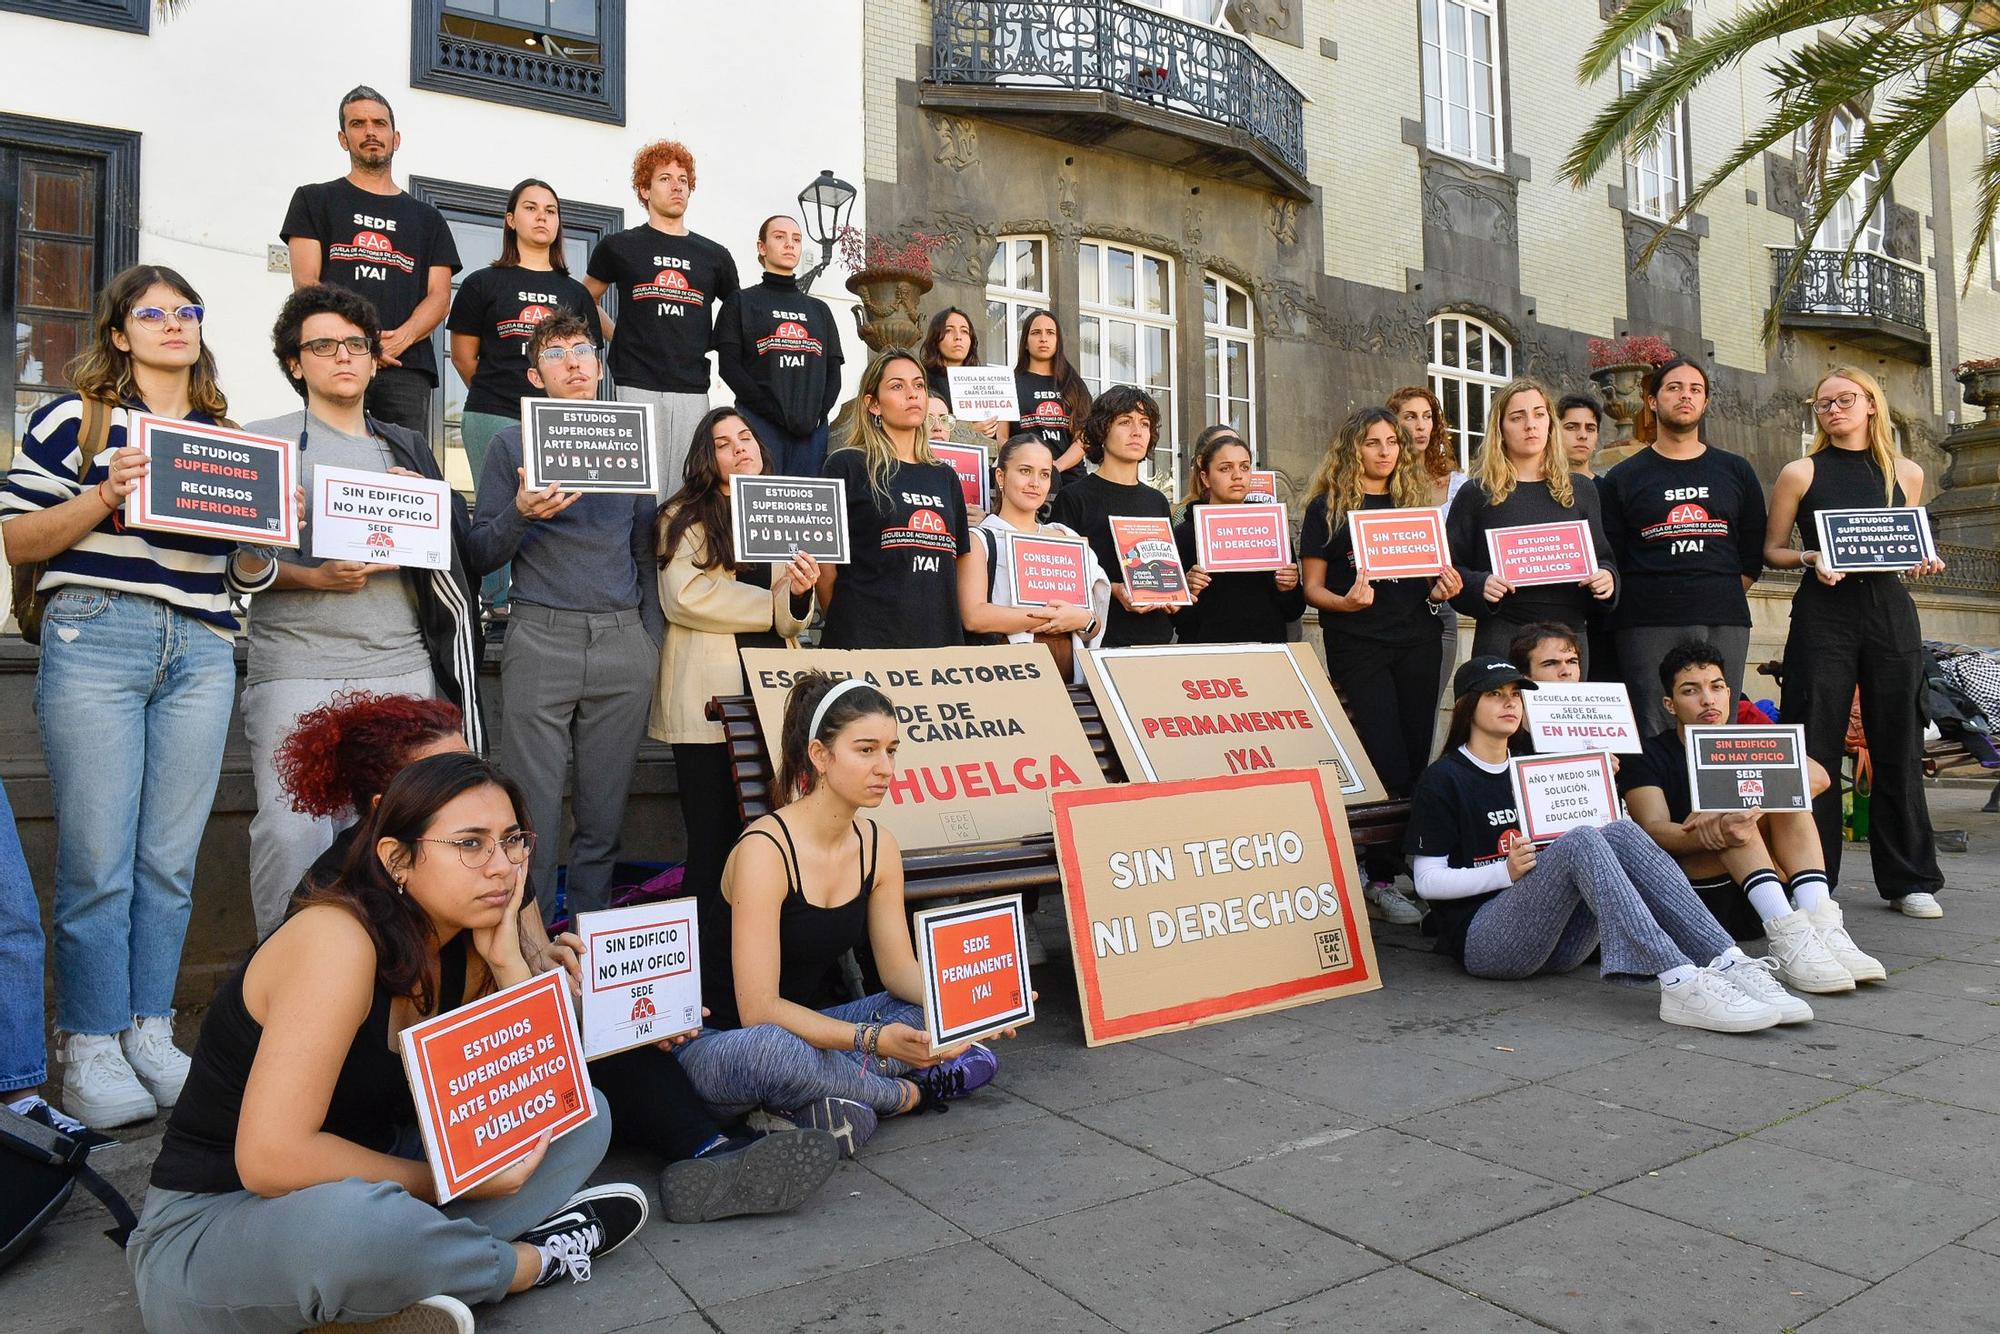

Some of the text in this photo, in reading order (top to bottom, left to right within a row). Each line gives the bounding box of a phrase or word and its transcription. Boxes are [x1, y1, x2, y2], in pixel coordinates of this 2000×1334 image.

[353, 213, 397, 231] SEDE
[358, 234, 388, 250] EAC
[653, 256, 691, 271] SEDE
[354, 265, 386, 280] ¡YA!
[659, 272, 685, 288] EAC
[518, 291, 558, 304] SEDE
[657, 303, 684, 316] ¡YA!
[772, 310, 808, 321] SEDE
[780, 324, 805, 337] EAC
[779, 354, 804, 368] ¡YA!
[959, 400, 1013, 409] EN HUELGA
[1039, 403, 1060, 416] EAC
[563, 413, 617, 424] ESTUDIOS
[548, 426, 633, 438] SUPERIORES DE
[544, 439, 639, 452] ARTE DRAMÁTICO
[182, 443, 251, 463] ESTUDIOS
[545, 452, 639, 469] PÚBLICOS
[174, 458, 259, 481] SUPERIORES
[181, 481, 253, 502] RECURSOS
[342, 486, 424, 505] SIN EDIFICIO
[765, 488, 814, 498] ESTUDIOS
[1664, 487, 1709, 501] SEDE
[752, 501, 828, 512] SUPERIORES DE
[902, 492, 944, 507] SEDE
[176, 497, 258, 519] INFERIORES
[333, 501, 432, 521] NO HAY OFICIO
[1672, 506, 1703, 523] EAC
[748, 513, 833, 525] ARTE DRAMÁTICO
[913, 512, 942, 531] EAC
[1848, 516, 1894, 524] ESTUDIOS
[367, 523, 394, 533] SEDE
[750, 527, 834, 542] PÚBLICOS
[1216, 526, 1270, 537] SIN TECHO
[1838, 526, 1894, 534] SUPERIORES
[1372, 531, 1426, 542] SIN TECHO
[1517, 535, 1560, 545] ESTUDIOS
[1835, 533, 1916, 543] ARTE DRAMÁTICO
[1139, 543, 1172, 553] HUELGA
[1211, 539, 1277, 550] NI DERECHOS
[1368, 544, 1436, 556] NI DERECHOS
[1507, 543, 1575, 556] SUPERIORES DE
[1671, 540, 1704, 555] ¡YA!
[1838, 544, 1918, 555] PÚBLICOS
[371, 550, 390, 558] ¡YA!
[1505, 552, 1581, 566] ARTE DRAMÁTICO
[913, 555, 939, 572] ¡YA!
[1518, 563, 1572, 575] PÚBLICOS
[1024, 566, 1077, 579] ¿EL EDIFICIO
[1027, 578, 1076, 592] ALGÚN DÍA?
[886, 670, 924, 688] DE
[930, 662, 1042, 688] ACTORES
[1181, 678, 1249, 701] SEDE
[937, 702, 976, 721] DE
[906, 717, 1026, 743] CANARIA
[1141, 709, 1314, 739] PERMANENTE
[1542, 726, 1628, 737] EN HUELGA
[1715, 740, 1777, 749] SIN EDIFICIO
[1224, 745, 1276, 775] ¡YA!
[1711, 752, 1785, 762] NO HAY OFICIO
[888, 753, 1083, 806] HUELGA
[1528, 769, 1600, 784] AÑO Y MEDIO SIN
[1736, 770, 1763, 779] SEDE
[1544, 783, 1590, 796] SOLUCIÓN,
[1550, 798, 1576, 810] ¿ESTO
[1743, 797, 1762, 807] ¡YA!
[943, 813, 970, 824] SEDE
[1545, 808, 1598, 822] EDUCACIÓN?
[950, 822, 969, 832] EAC
[955, 831, 970, 839] YA
[1108, 830, 1304, 890] SIN TECHO
[1092, 882, 1339, 959] NI DERECHOS
[605, 929, 678, 954] SIN EDIFICIO
[962, 935, 991, 954] SEDE
[1319, 931, 1341, 945] SEDE
[1323, 943, 1340, 955] EAC
[1327, 953, 1340, 964] YA
[599, 951, 686, 981] NO HAY OFICIO
[942, 952, 1014, 985] PERMANENTE
[631, 984, 654, 999] SEDE
[971, 981, 992, 1006] ¡YA!
[634, 999, 656, 1019] EAC
[635, 1020, 653, 1039] ¡YA!
[463, 1017, 533, 1061] ESTUDIOS
[448, 1032, 556, 1097] SUPERIORES DE
[449, 1055, 567, 1128] ARTE DRAMÁTICO
[474, 1088, 557, 1148] PÚBLICOS
